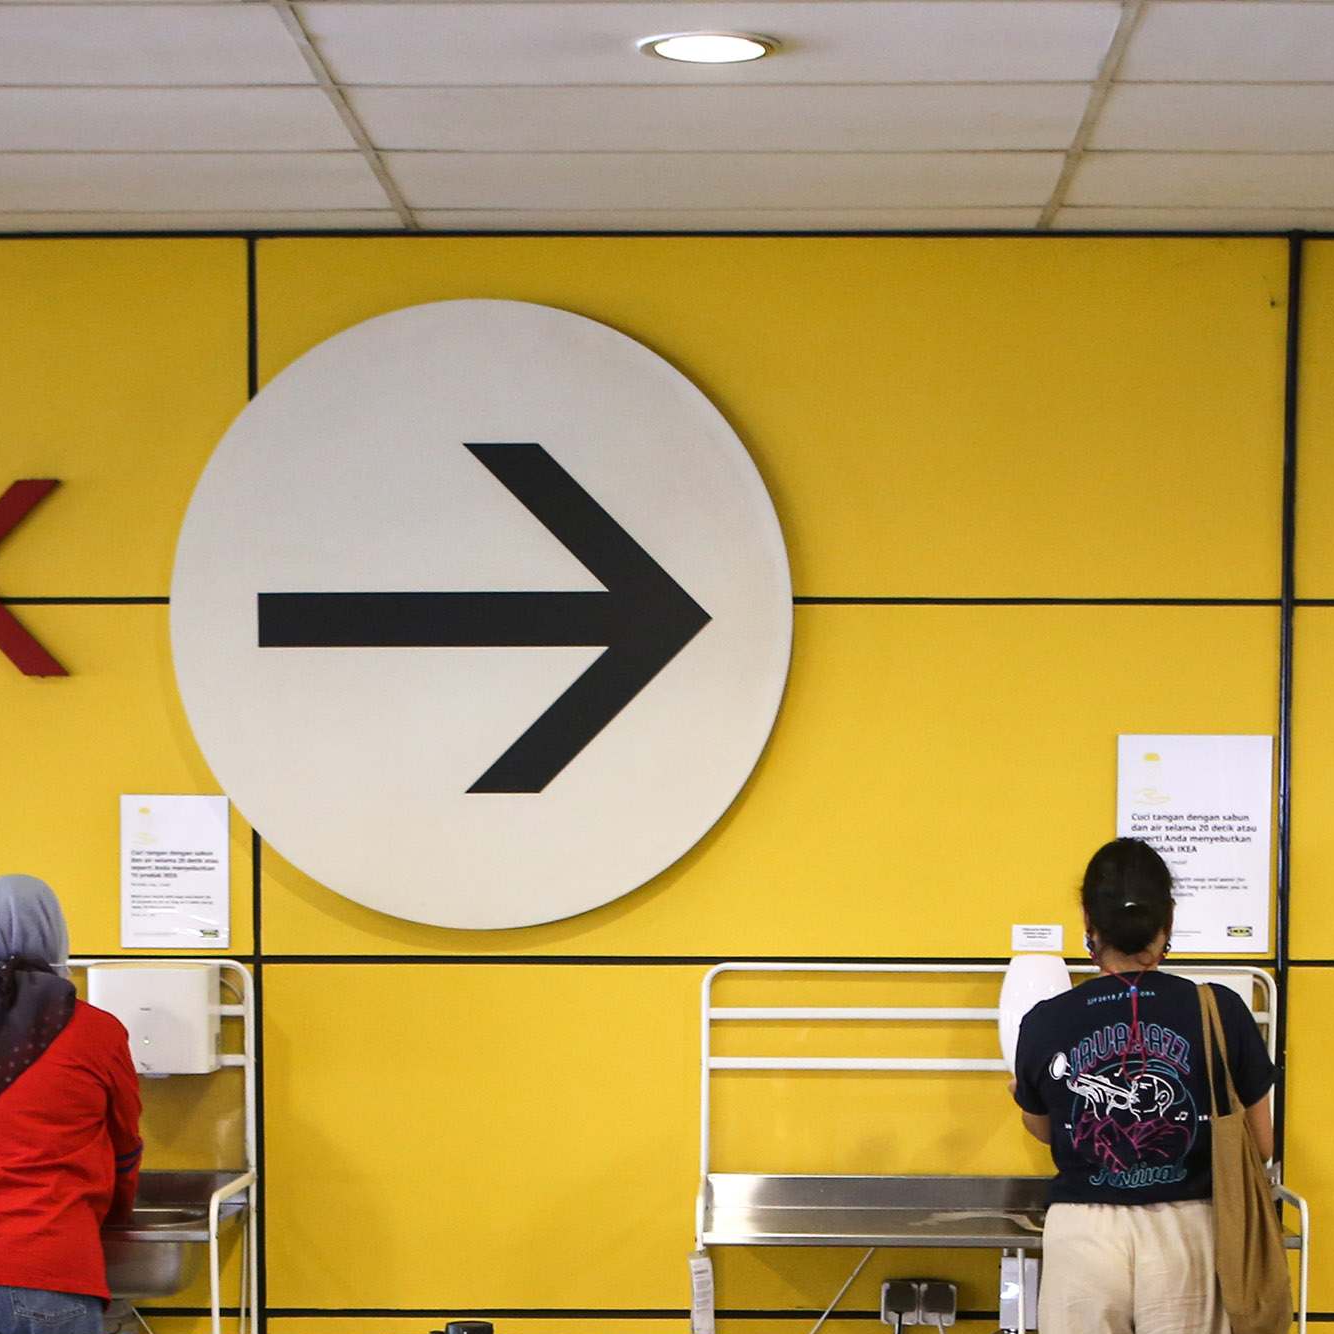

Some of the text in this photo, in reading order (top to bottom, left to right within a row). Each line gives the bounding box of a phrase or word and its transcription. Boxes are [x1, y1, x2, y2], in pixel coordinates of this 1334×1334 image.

[1131, 813, 1250, 823] Cuci tangan dengan sabun
[1131, 824, 1148, 832] dan
[1150, 824, 1162, 832] air
[1164, 824, 1197, 832] selama
[1198, 824, 1210, 832] 20
[1211, 824, 1234, 832] detik
[1189, 835, 1252, 844] menyebutkan
[1177, 845, 1198, 853] IKEA
